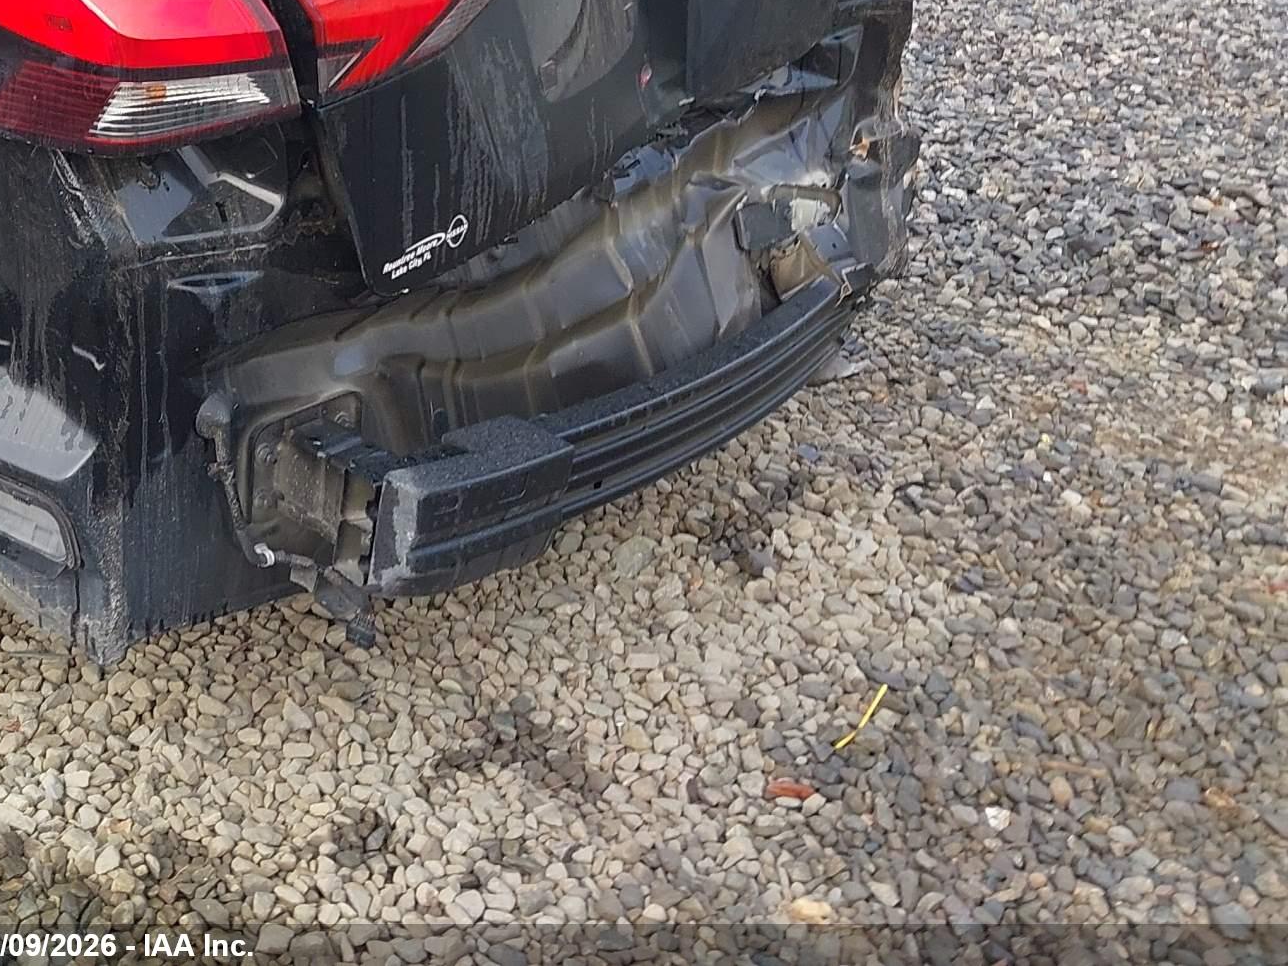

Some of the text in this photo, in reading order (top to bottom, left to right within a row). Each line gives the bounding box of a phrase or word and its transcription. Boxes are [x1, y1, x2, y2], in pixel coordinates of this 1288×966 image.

[446, 223, 469, 241] NISSAN
[382, 239, 438, 275] Rountree Moore
[391, 265, 408, 280] Lake
[423, 251, 432, 262] FL
